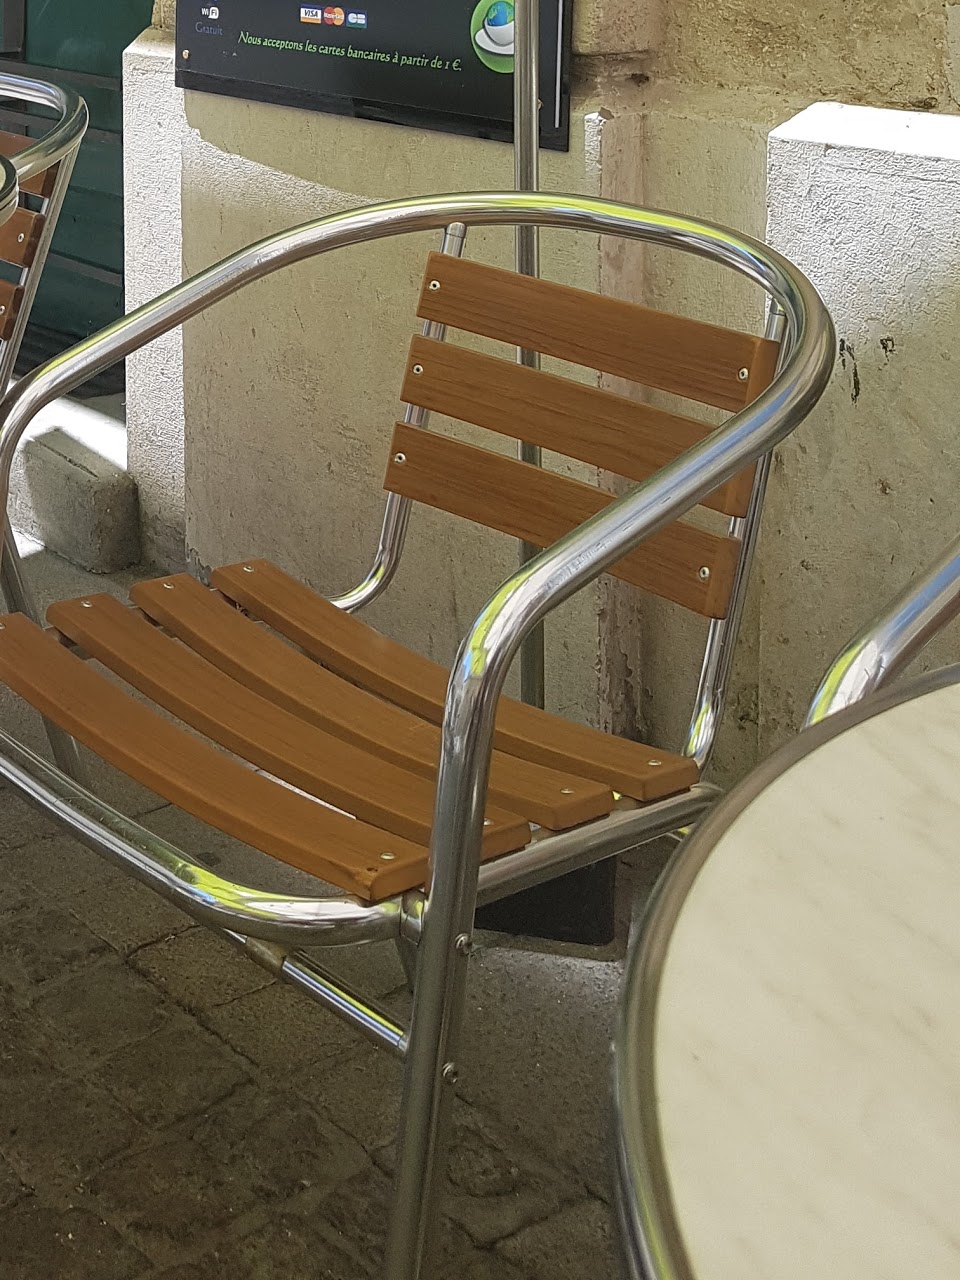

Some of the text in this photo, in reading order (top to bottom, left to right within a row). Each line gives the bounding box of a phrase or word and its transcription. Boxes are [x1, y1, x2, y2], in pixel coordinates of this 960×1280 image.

[304, 9, 319, 18] VISA
[195, 21, 223, 36] Gratuit
[238, 31, 261, 45] Nous
[263, 37, 303, 51] acceptons
[305, 40, 316, 52] les
[318, 44, 345, 56] cartes
[347, 45, 390, 62] bancaires
[393, 52, 399, 63] à
[401, 55, 429, 66] partir
[431, 55, 442, 69] de
